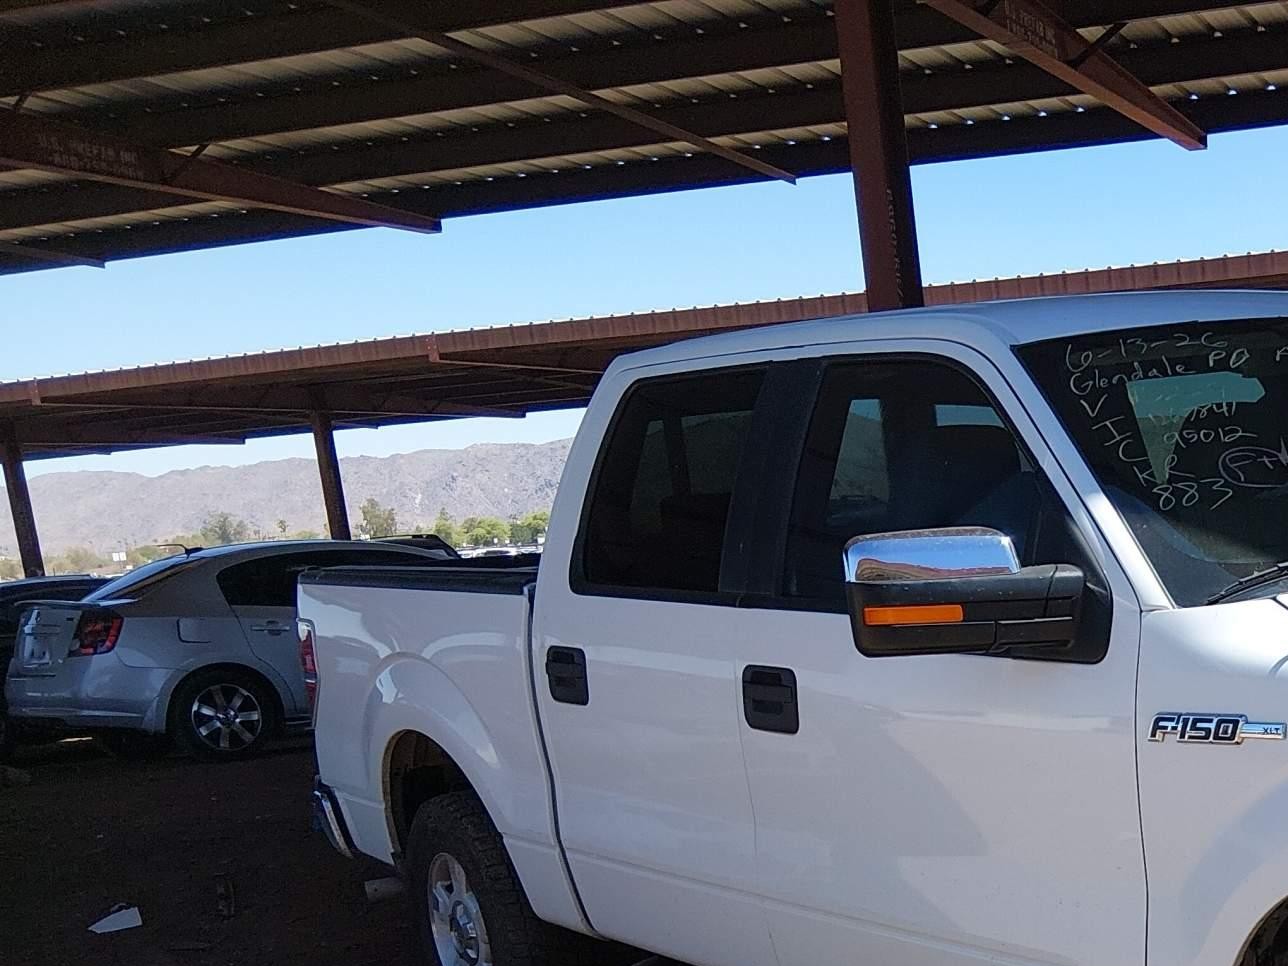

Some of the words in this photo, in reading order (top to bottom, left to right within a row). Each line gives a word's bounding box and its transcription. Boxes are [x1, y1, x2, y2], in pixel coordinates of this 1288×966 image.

[1069, 356, 1197, 396] Glendale
[1151, 477, 1234, 511] 883
[1148, 711, 1248, 744] F-150
[1262, 726, 1281, 736] XLT
